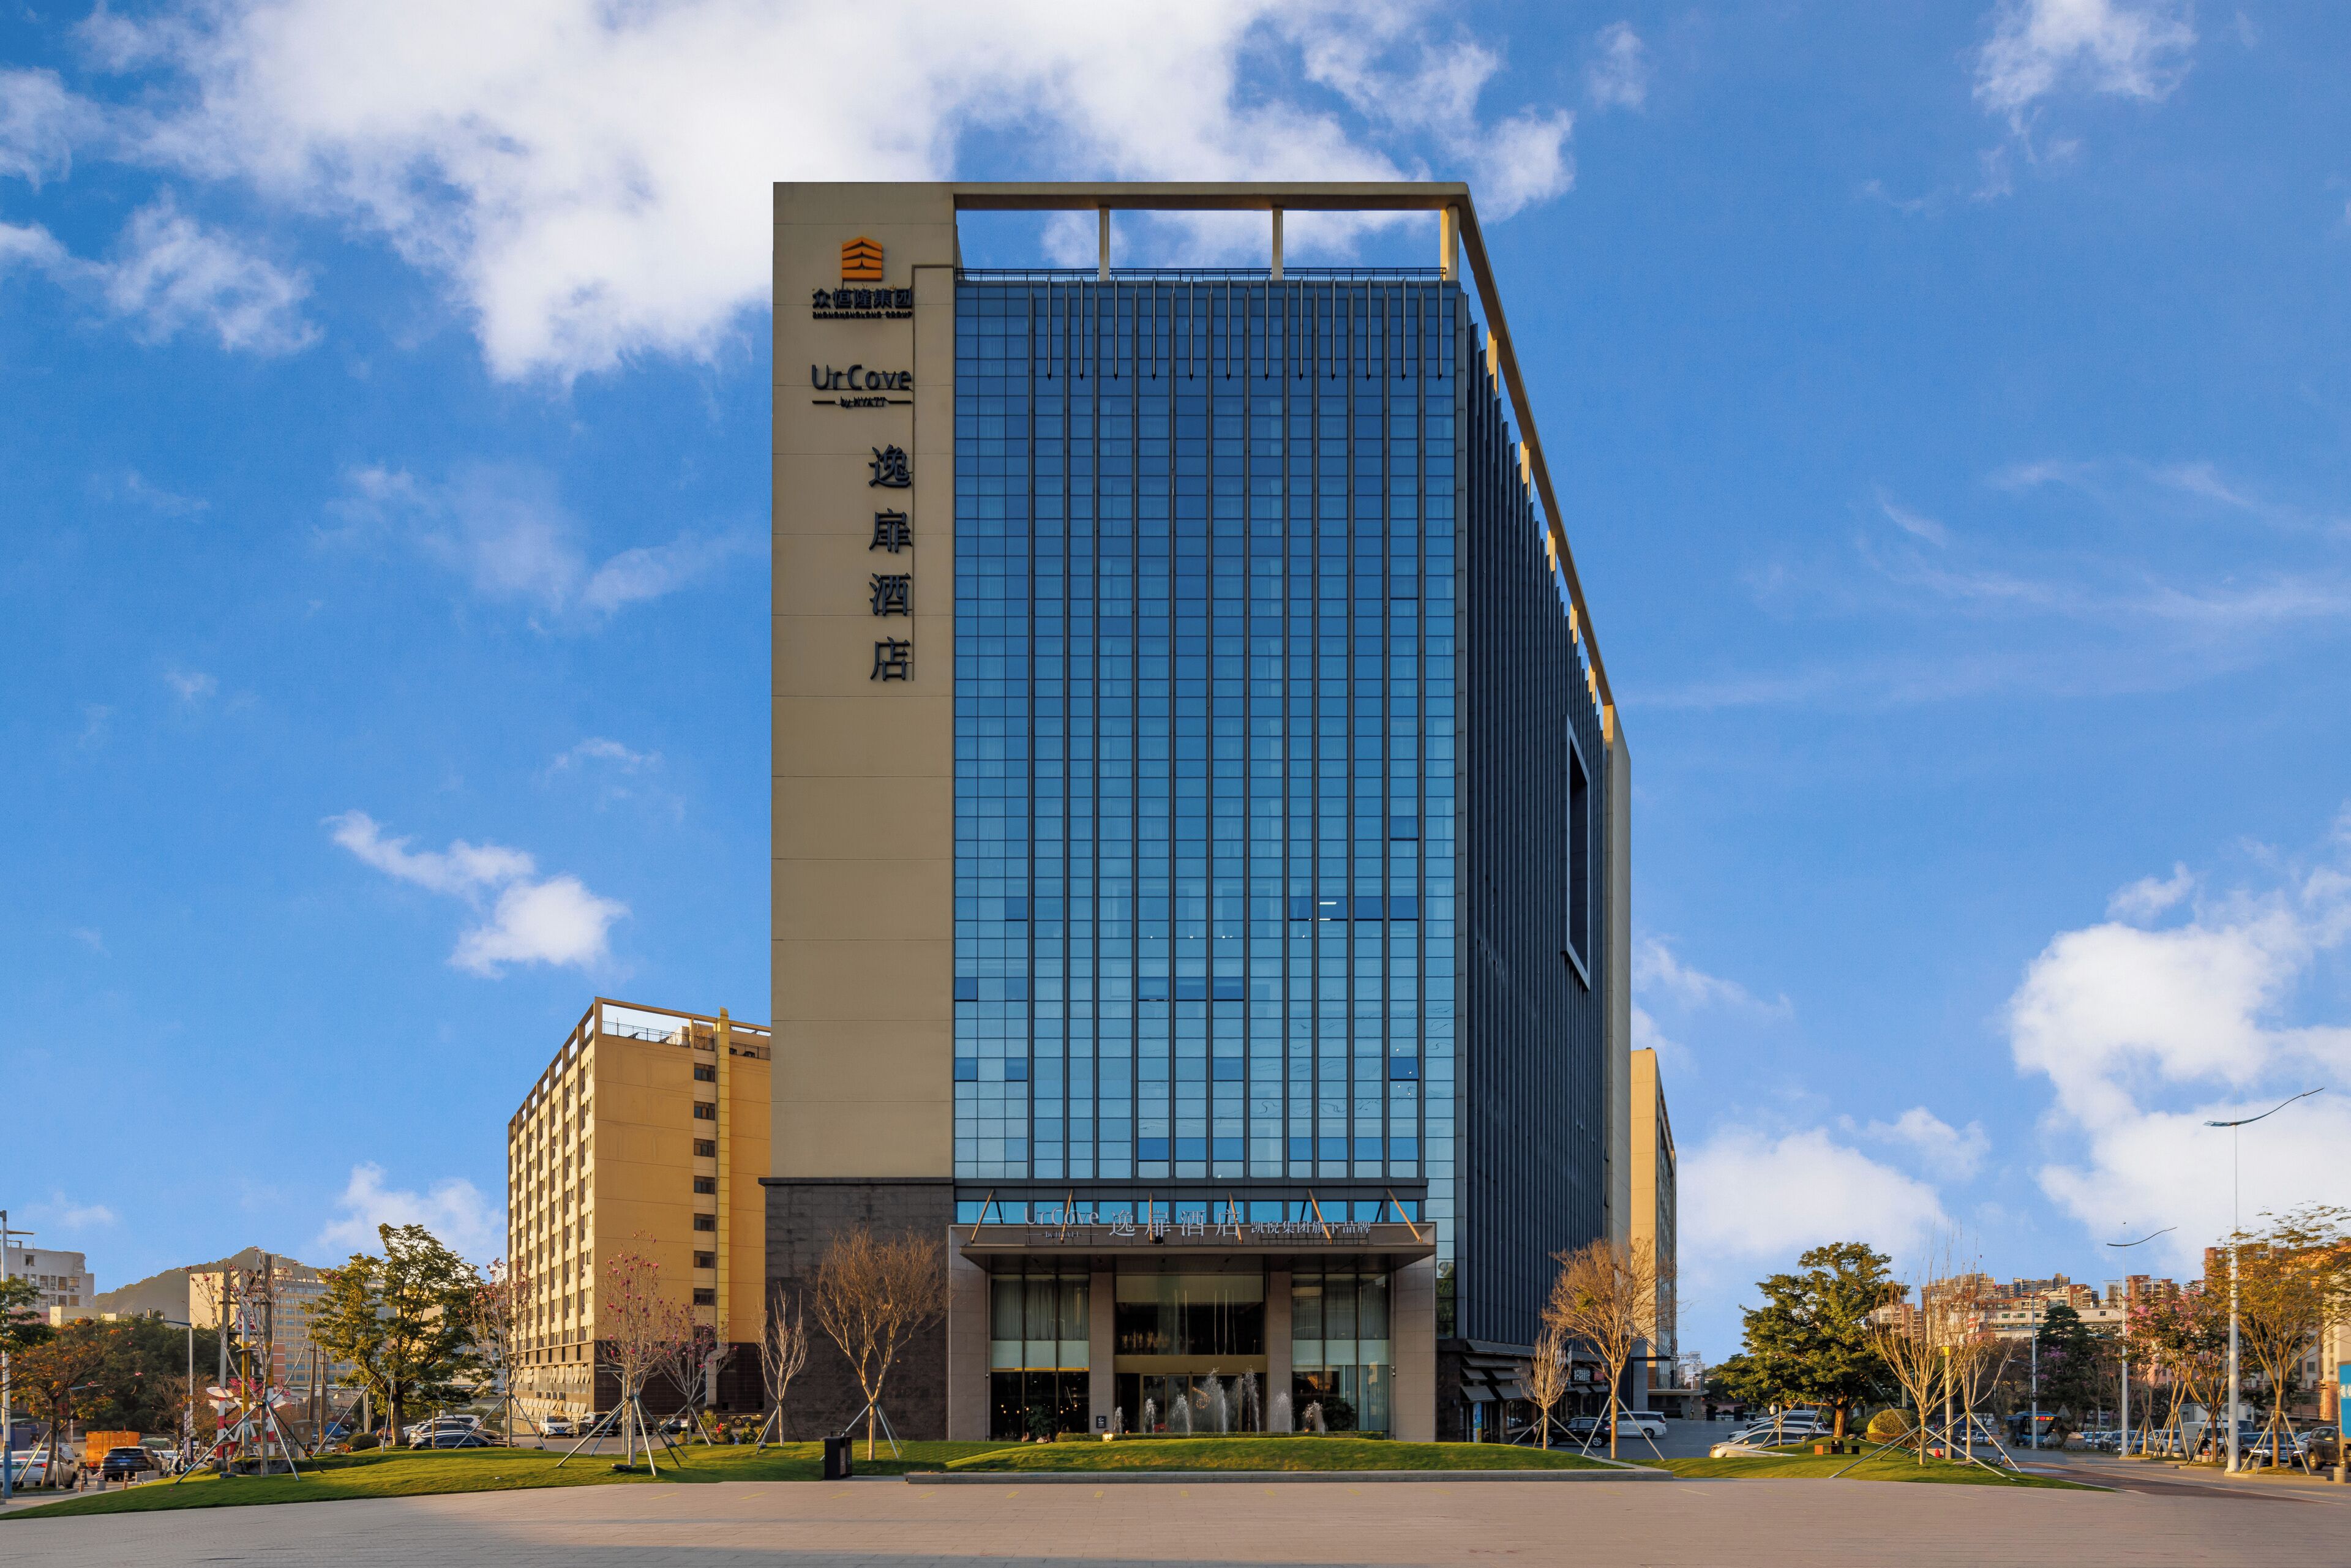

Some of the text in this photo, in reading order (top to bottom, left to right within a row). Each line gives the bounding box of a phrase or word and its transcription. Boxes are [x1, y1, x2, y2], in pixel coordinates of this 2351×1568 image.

[812, 288, 912, 309] 众恒隆集团
[812, 364, 912, 391] UrCove
[854, 397, 885, 407] HYATT
[868, 444, 912, 681] 逸扉酒店
[1024, 1207, 1099, 1225] UrCove
[1109, 1209, 1371, 1237] 逸扉酒店 凯悦集团旗下品牌
